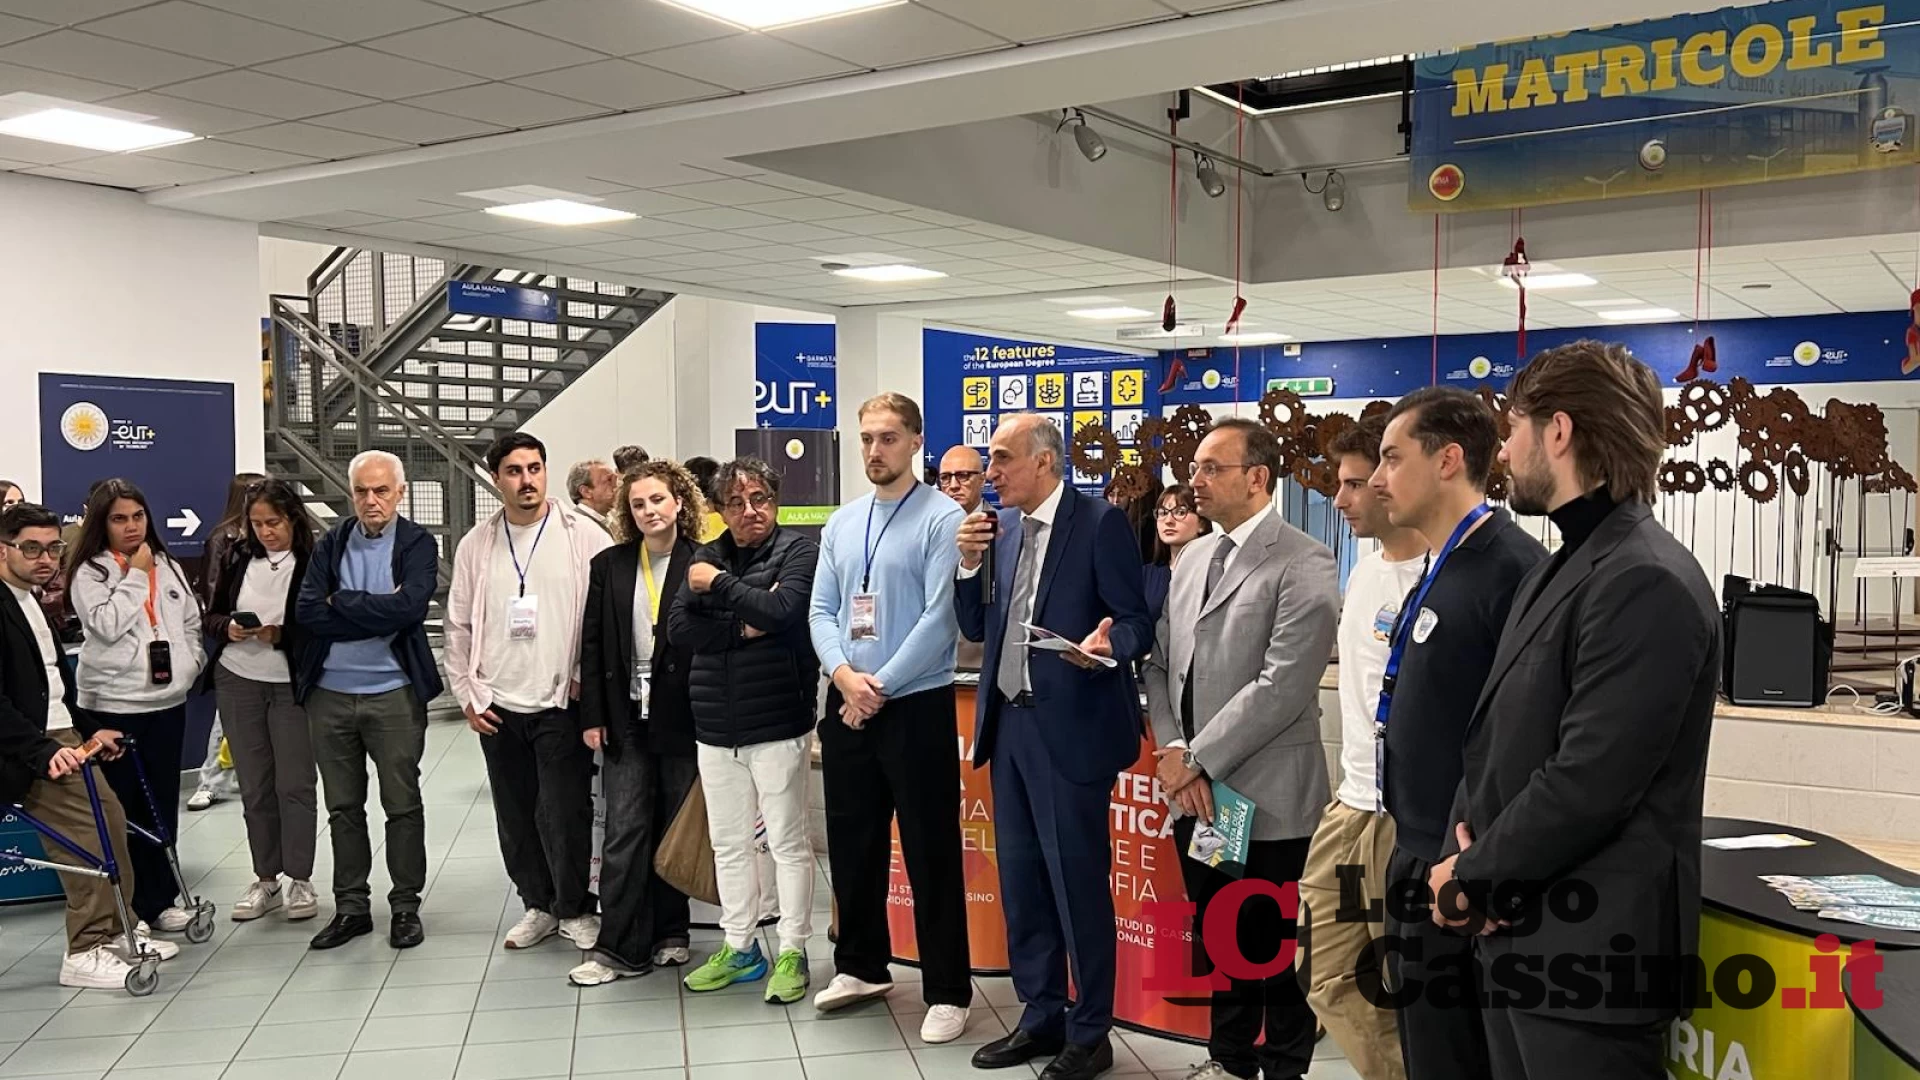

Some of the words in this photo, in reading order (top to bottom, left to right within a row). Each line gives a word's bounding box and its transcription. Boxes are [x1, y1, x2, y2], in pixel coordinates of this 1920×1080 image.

[1451, 5, 1887, 117] MATRICOLE
[462, 283, 480, 291] AULA
[481, 285, 506, 294] MAGNA
[963, 354, 975, 362] the
[975, 347, 989, 361] 12
[992, 346, 1055, 360] features
[985, 360, 1023, 369] European
[1025, 359, 1055, 368] Degree
[787, 513, 809, 521] AULA
[1110, 772, 1169, 805] TER
[1234, 802, 1249, 857] MATRICOLE
[1141, 844, 1156, 871] E
[1110, 873, 1158, 902] FIA
[1115, 930, 1154, 948] ONALE
[1668, 1015, 1754, 1080] RIA
